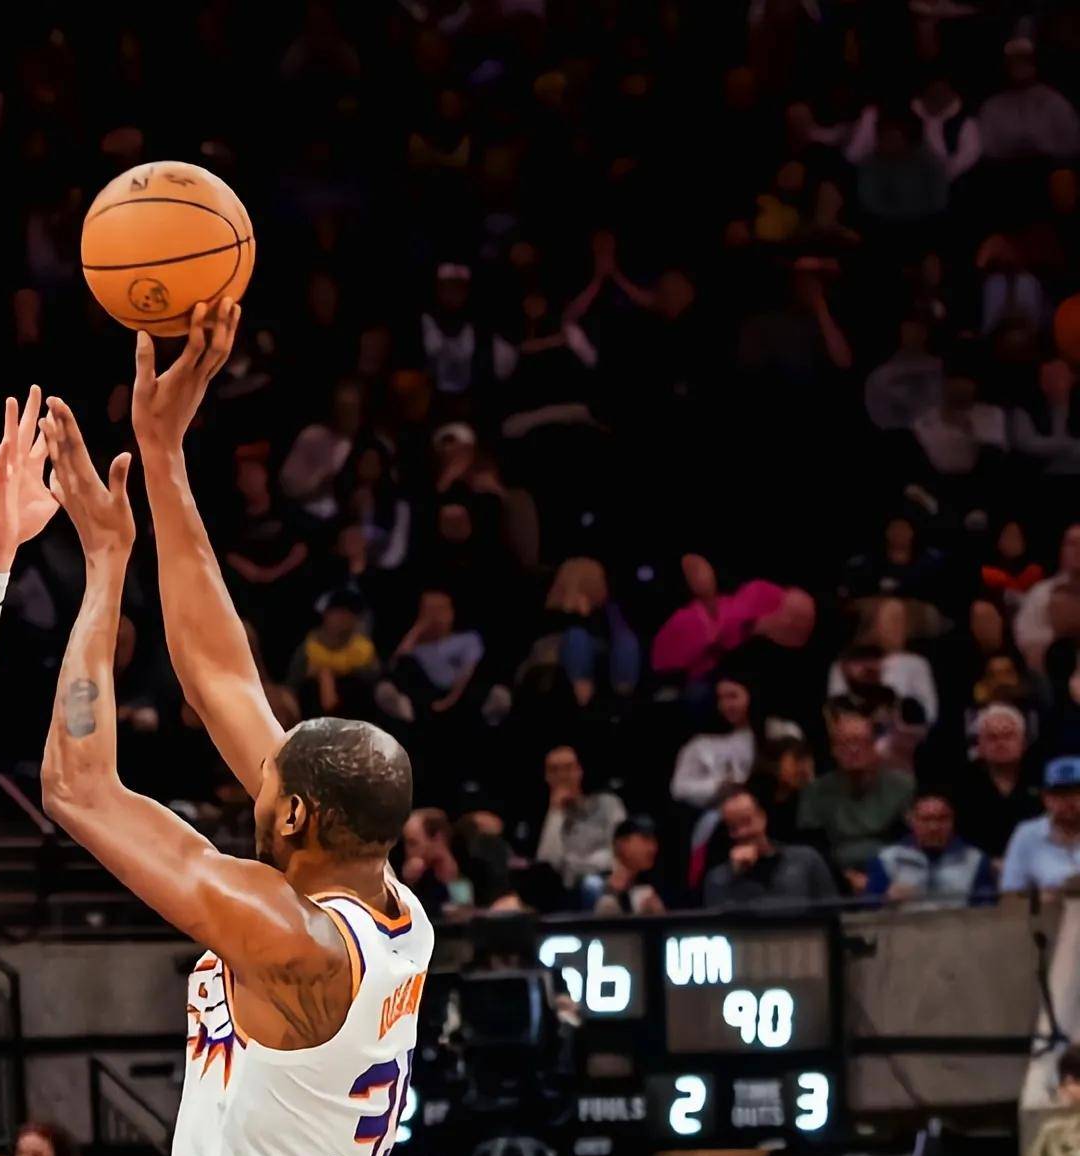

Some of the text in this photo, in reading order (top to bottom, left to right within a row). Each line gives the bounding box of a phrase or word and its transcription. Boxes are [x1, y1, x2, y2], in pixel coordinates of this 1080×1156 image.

[722, 987, 794, 1048] 90
[669, 1075, 706, 1135] 2
[795, 1072, 829, 1131] 3
